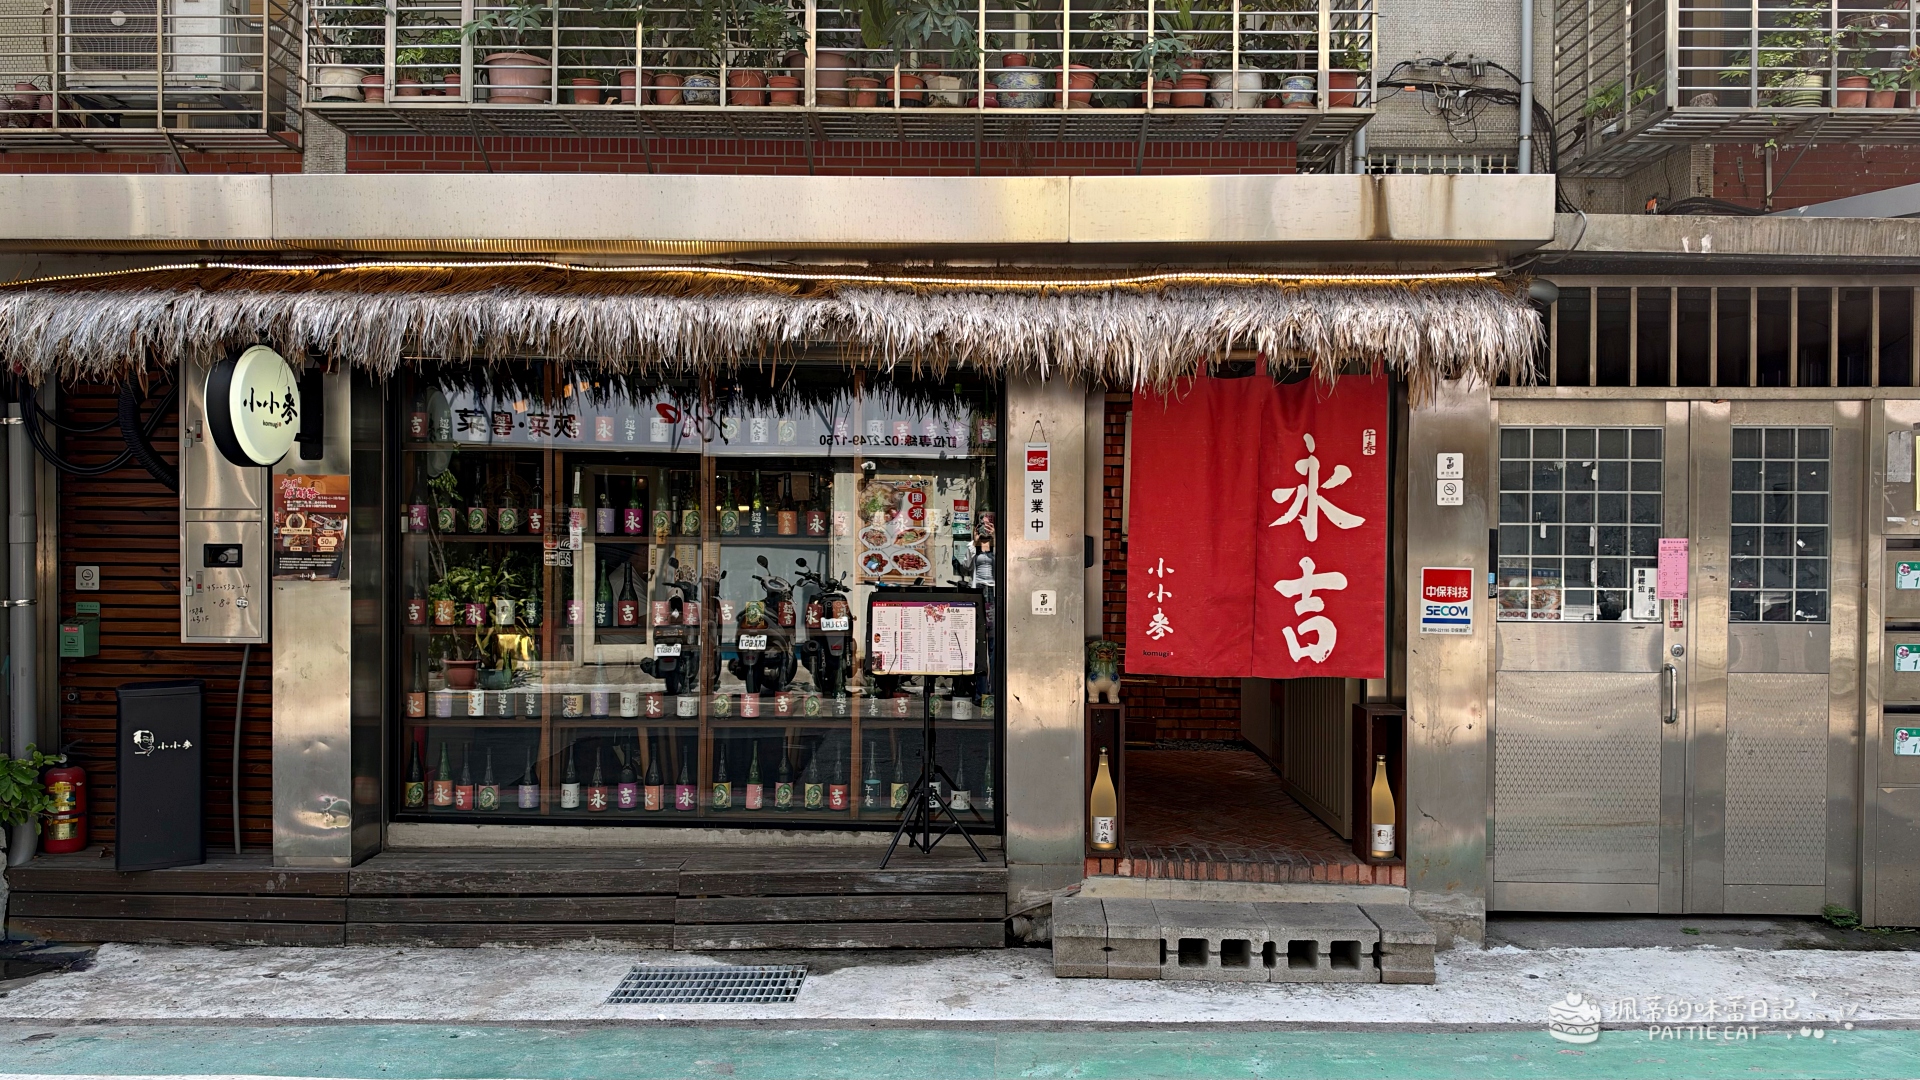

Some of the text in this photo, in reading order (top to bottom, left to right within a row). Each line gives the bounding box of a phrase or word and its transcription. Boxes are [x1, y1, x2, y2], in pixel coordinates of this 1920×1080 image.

[411, 416, 422, 433] 吉
[597, 420, 612, 439] 永
[530, 512, 542, 529] 吉
[625, 512, 641, 530] 永
[810, 514, 825, 533] 永
[1269, 433, 1366, 663] 永吉
[1146, 557, 1175, 640] 小小麥
[1425, 585, 1469, 598] 中保科技
[408, 603, 420, 620] 吉
[436, 604, 450, 622] 永
[467, 605, 483, 624] 永
[568, 604, 580, 621] 吉
[622, 604, 635, 621] 吉
[721, 604, 733, 621] 吉
[805, 607, 820, 625] 永
[1426, 605, 1468, 617] SECOM
[1143, 650, 1170, 658] komugi
[407, 696, 421, 715] 永
[646, 696, 661, 715] 永
[777, 696, 789, 712] 吉
[897, 697, 909, 713] 吉
[434, 784, 450, 803] 永
[455, 789, 466, 806] 吉
[590, 790, 606, 809] 永
[620, 788, 633, 804] 吉
[679, 788, 694, 807] 永
[831, 788, 843, 806] 吉
